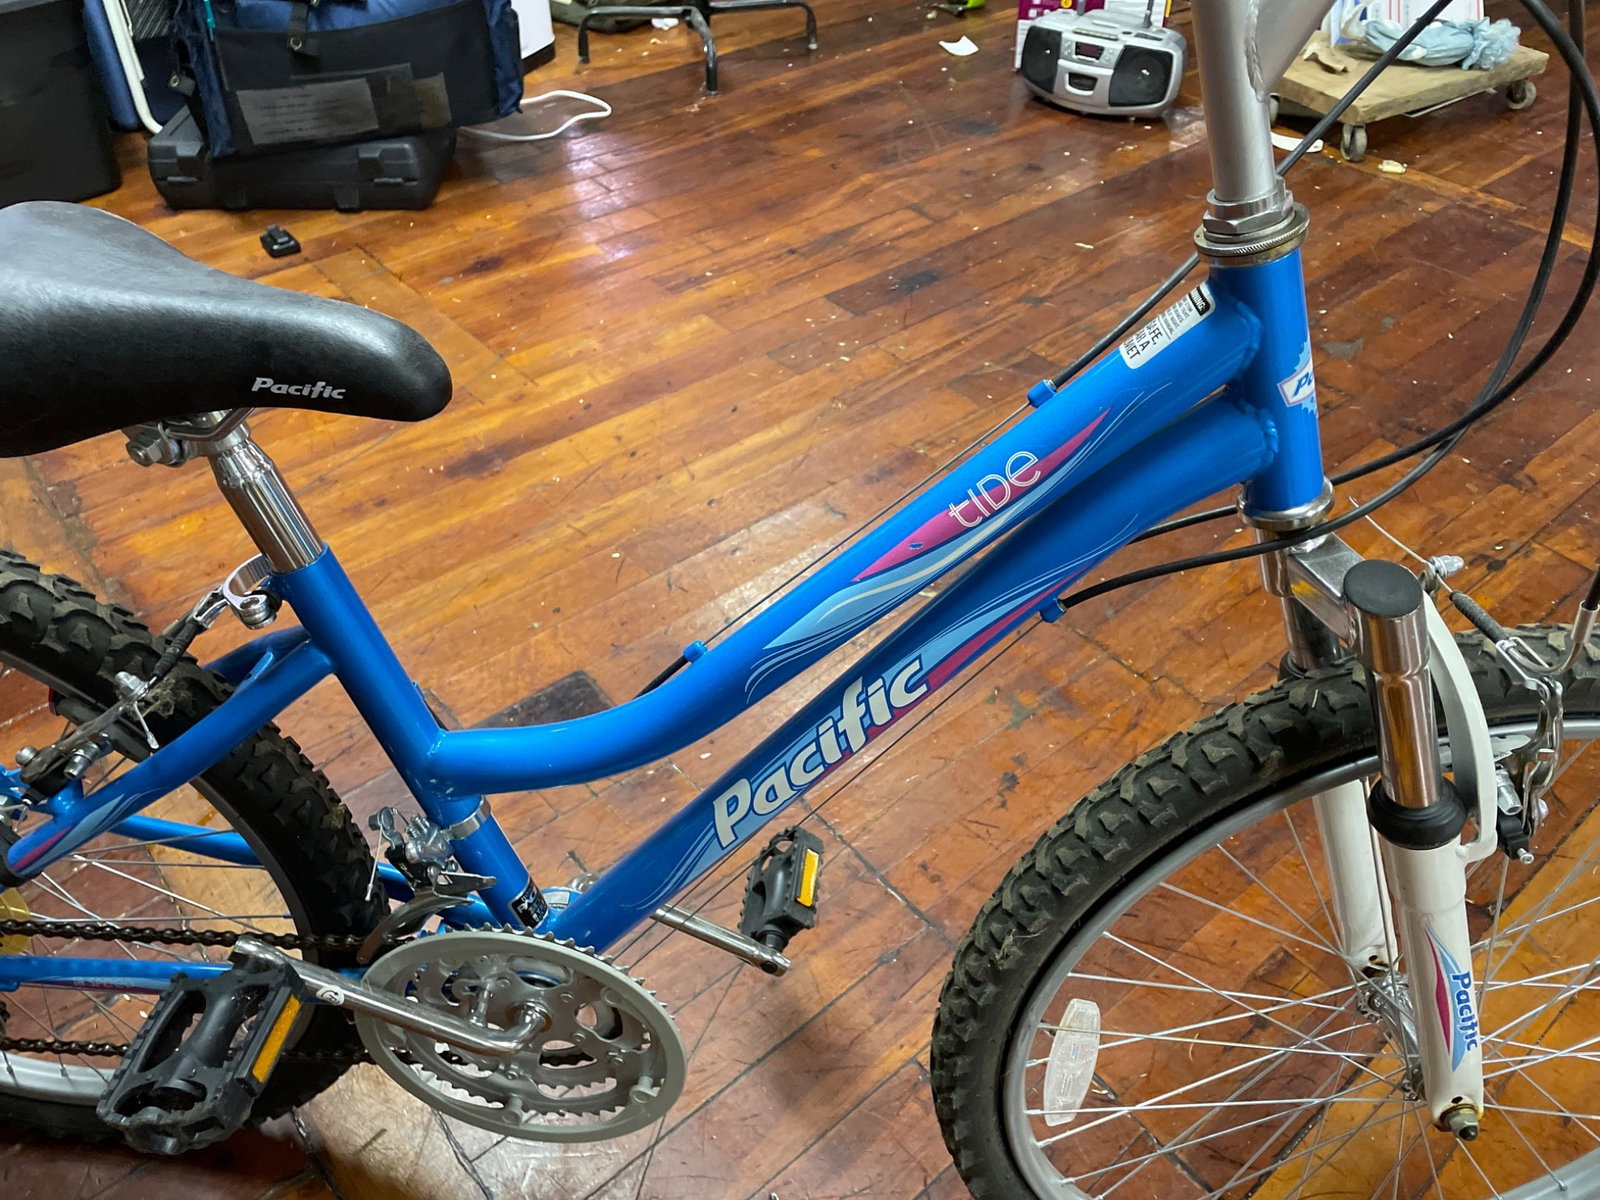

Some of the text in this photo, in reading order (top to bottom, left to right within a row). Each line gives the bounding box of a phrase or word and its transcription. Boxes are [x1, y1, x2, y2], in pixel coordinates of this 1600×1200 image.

[250, 377, 346, 399] Pacific
[712, 654, 931, 849] Pacific
[1451, 971, 1478, 1052] Pacific
